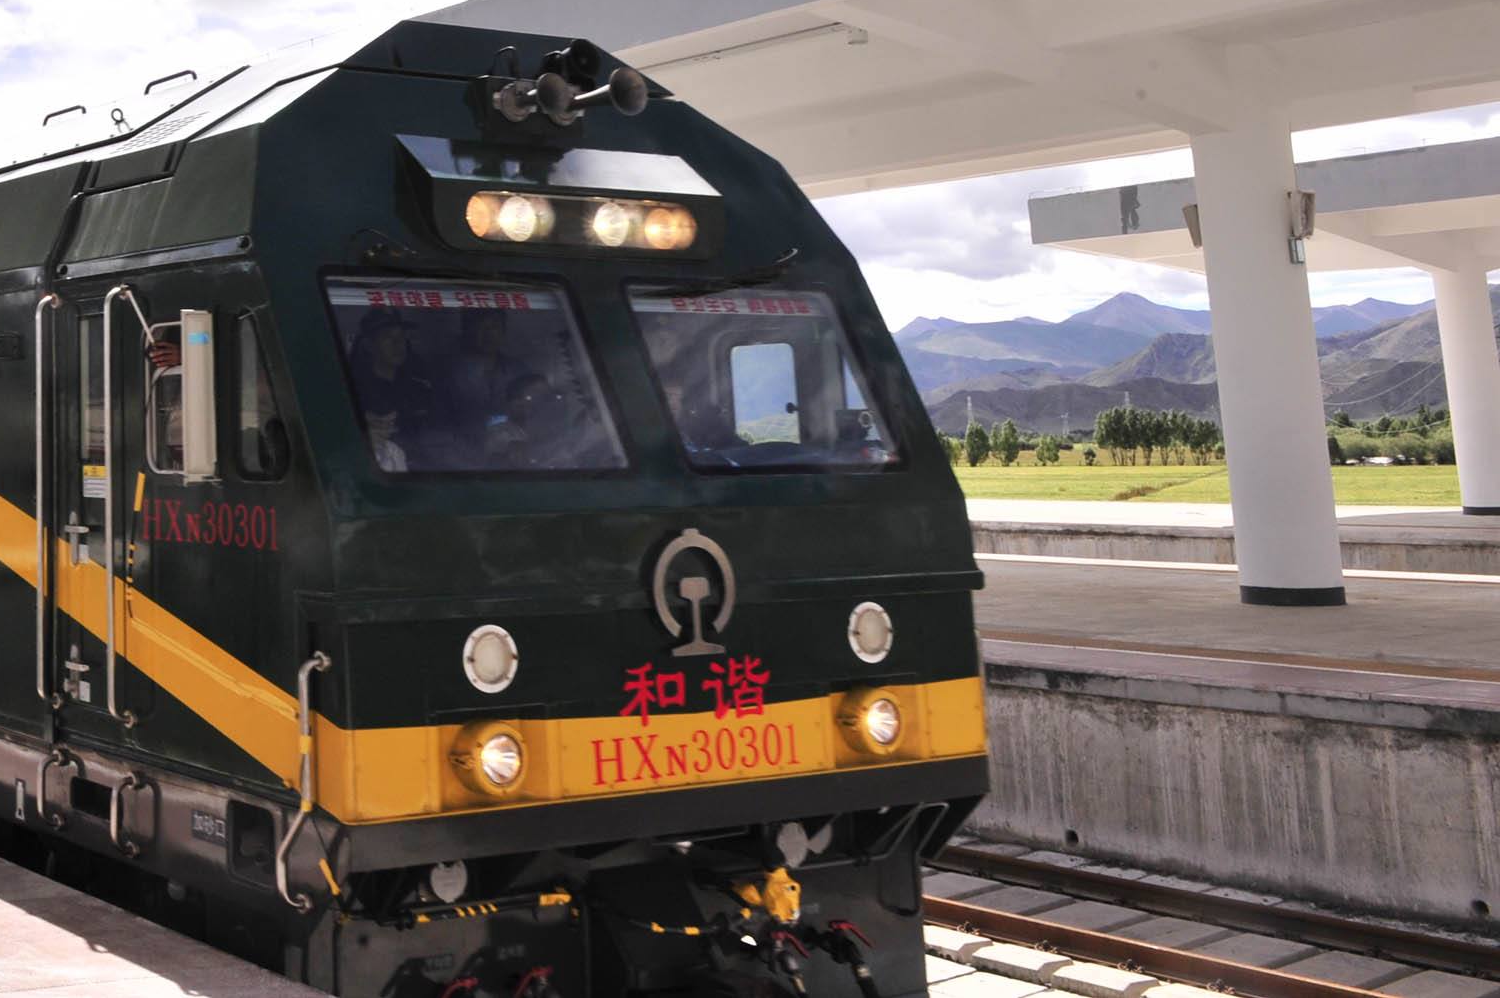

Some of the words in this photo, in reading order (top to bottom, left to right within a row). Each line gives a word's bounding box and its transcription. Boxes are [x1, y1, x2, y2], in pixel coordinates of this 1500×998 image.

[141, 498, 280, 551] HXN30301
[619, 655, 771, 727] 和谐
[591, 722, 801, 786] HXN30301
